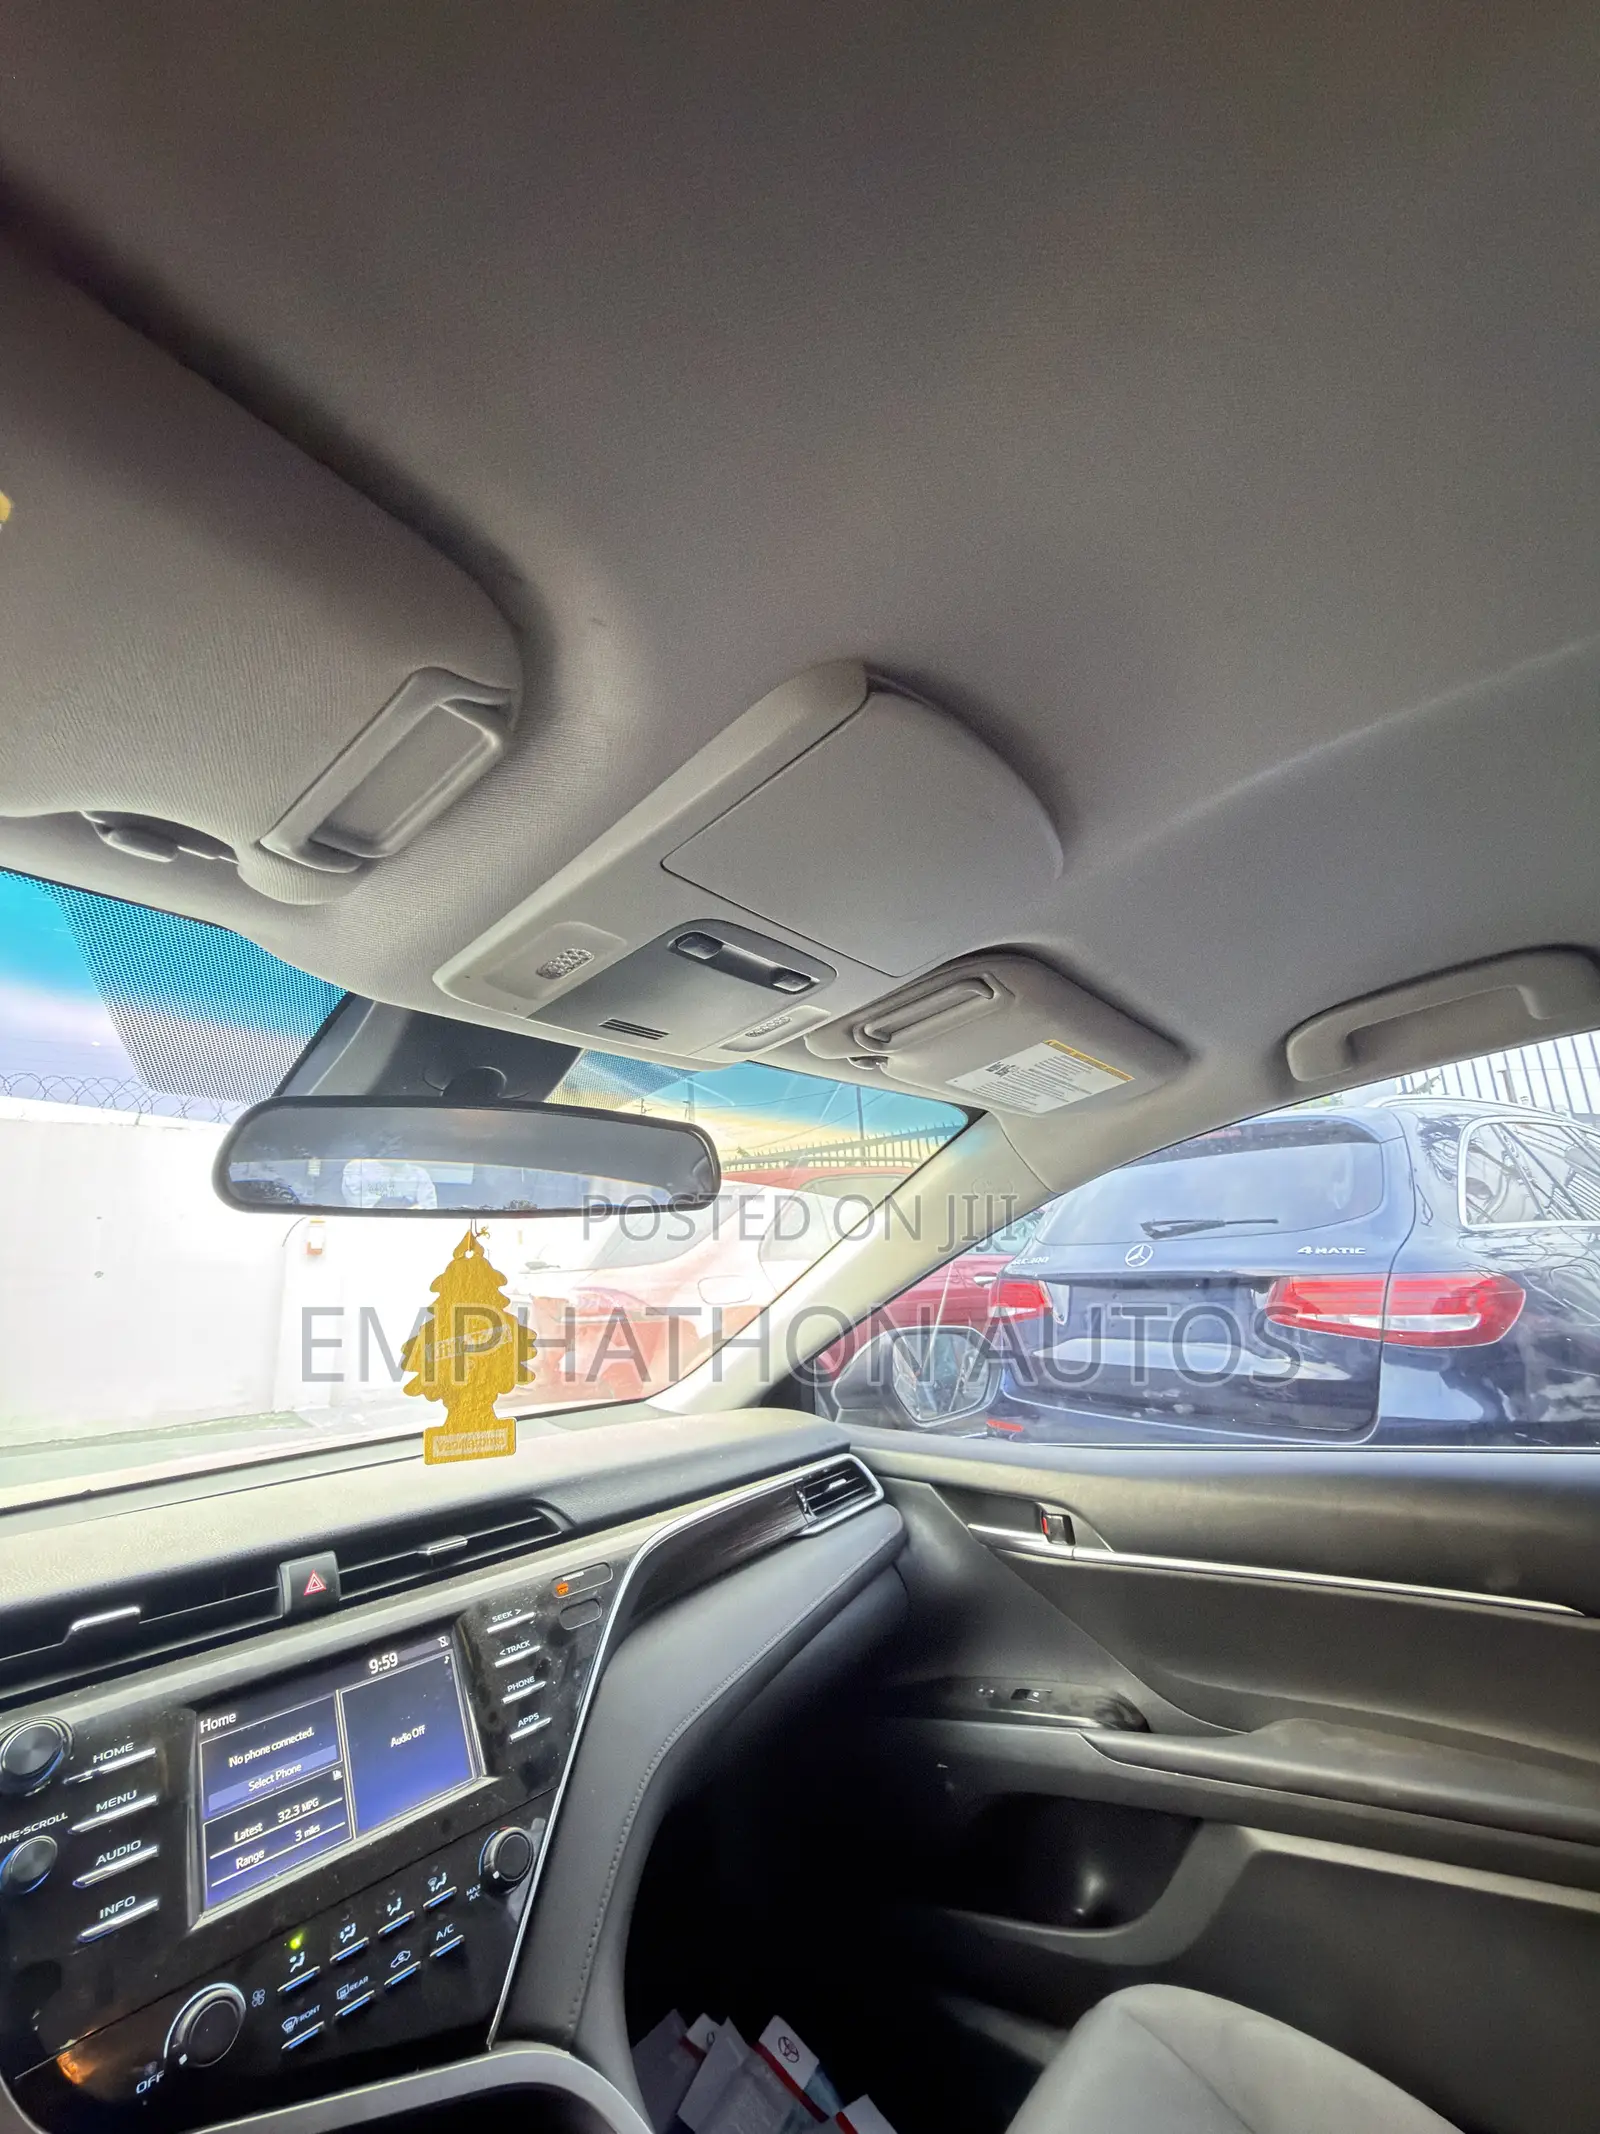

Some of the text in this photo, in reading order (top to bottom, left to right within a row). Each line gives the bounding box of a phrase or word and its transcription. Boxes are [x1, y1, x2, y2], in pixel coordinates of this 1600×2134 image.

[491, 1610, 513, 1623] SEEK
[368, 1652, 399, 1675] 9:59
[507, 1676, 535, 1692] PHONE
[200, 1712, 237, 1734] Home
[517, 1712, 540, 1728] APPS
[228, 1726, 315, 1768] No phone connected.
[390, 1724, 426, 1748] Audio Off
[92, 1742, 135, 1764] HOME
[248, 1763, 302, 1792] Select Phone
[95, 1789, 138, 1813] MENU
[233, 1797, 320, 1843] Latest 32.3 MPG
[95, 1839, 142, 1866] AUDIO
[235, 1824, 321, 1871] Range 3 miles
[99, 1895, 136, 1919] INFO
[435, 1923, 455, 1941] A/C
[349, 1975, 369, 1992] REAR
[136, 2070, 165, 2094] OFF
